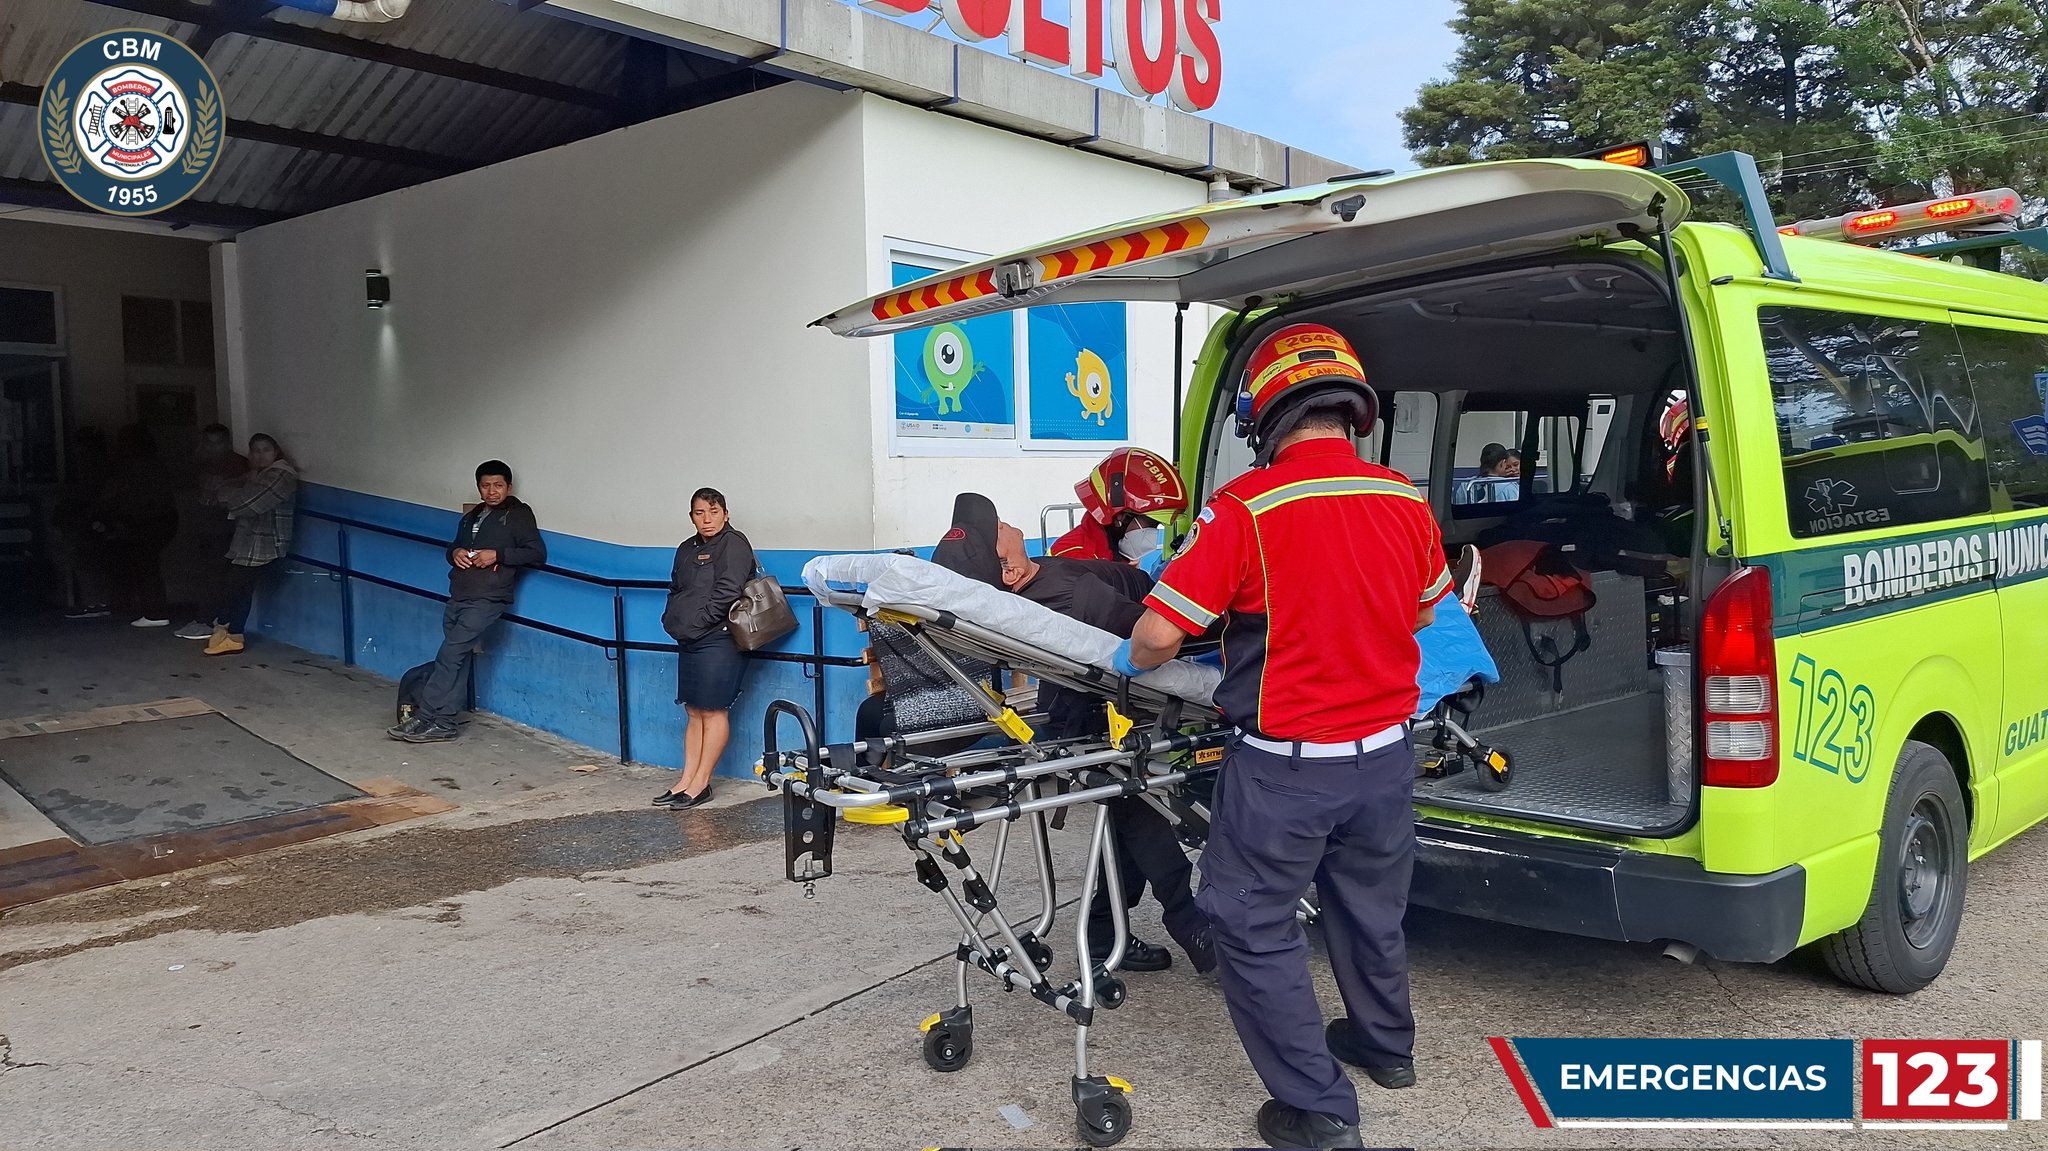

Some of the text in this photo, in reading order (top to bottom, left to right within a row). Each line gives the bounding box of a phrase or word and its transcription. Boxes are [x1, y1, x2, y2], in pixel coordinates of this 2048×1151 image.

[1286, 334, 1338, 347] 2646
[1143, 459, 1168, 485] CBM
[1842, 534, 1983, 606] BOMBEROS
[1789, 652, 1875, 784] 123
